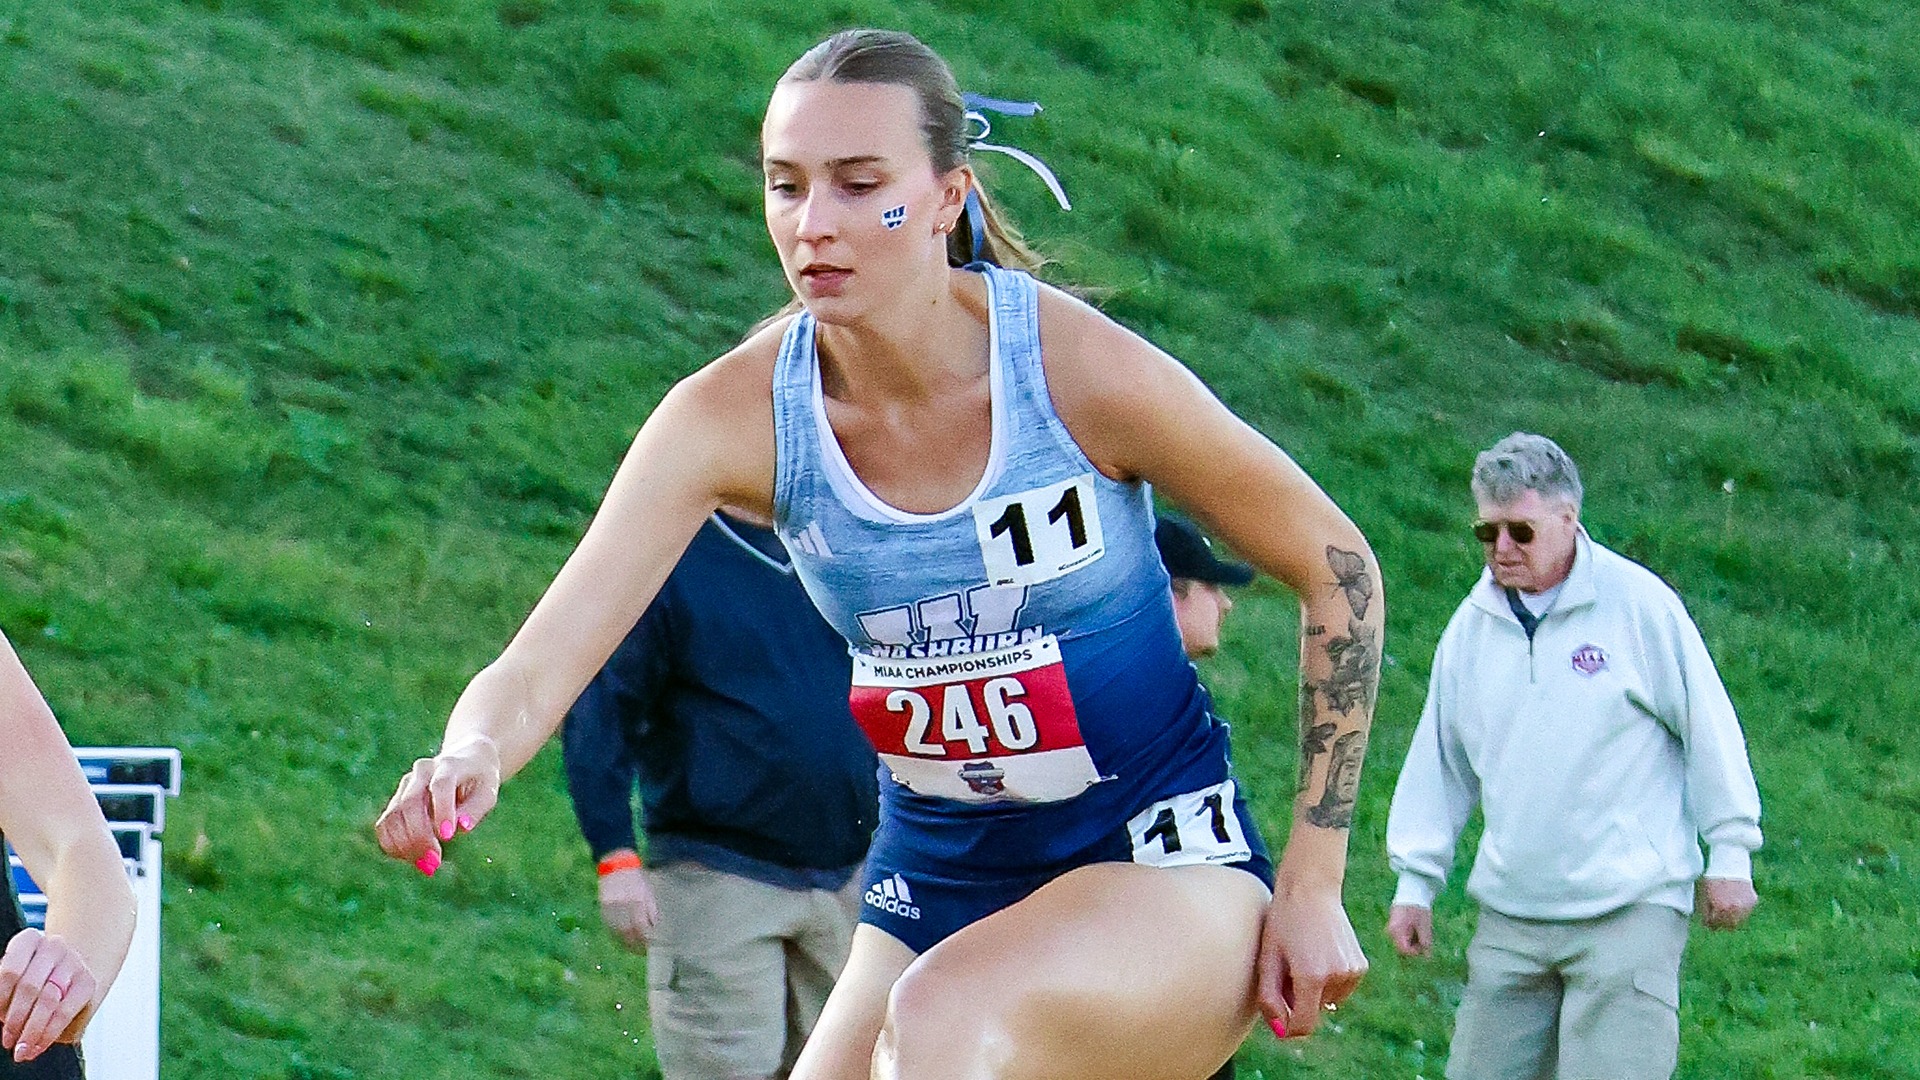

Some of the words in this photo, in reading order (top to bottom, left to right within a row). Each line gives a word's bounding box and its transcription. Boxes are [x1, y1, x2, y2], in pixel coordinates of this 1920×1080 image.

[989, 486, 1087, 567] 11
[874, 666, 903, 678] MIAA
[905, 649, 1032, 679] CHAMPIONSHIPS
[886, 677, 1038, 756] 246
[1143, 792, 1232, 855] 11
[864, 890, 921, 920] adidas
